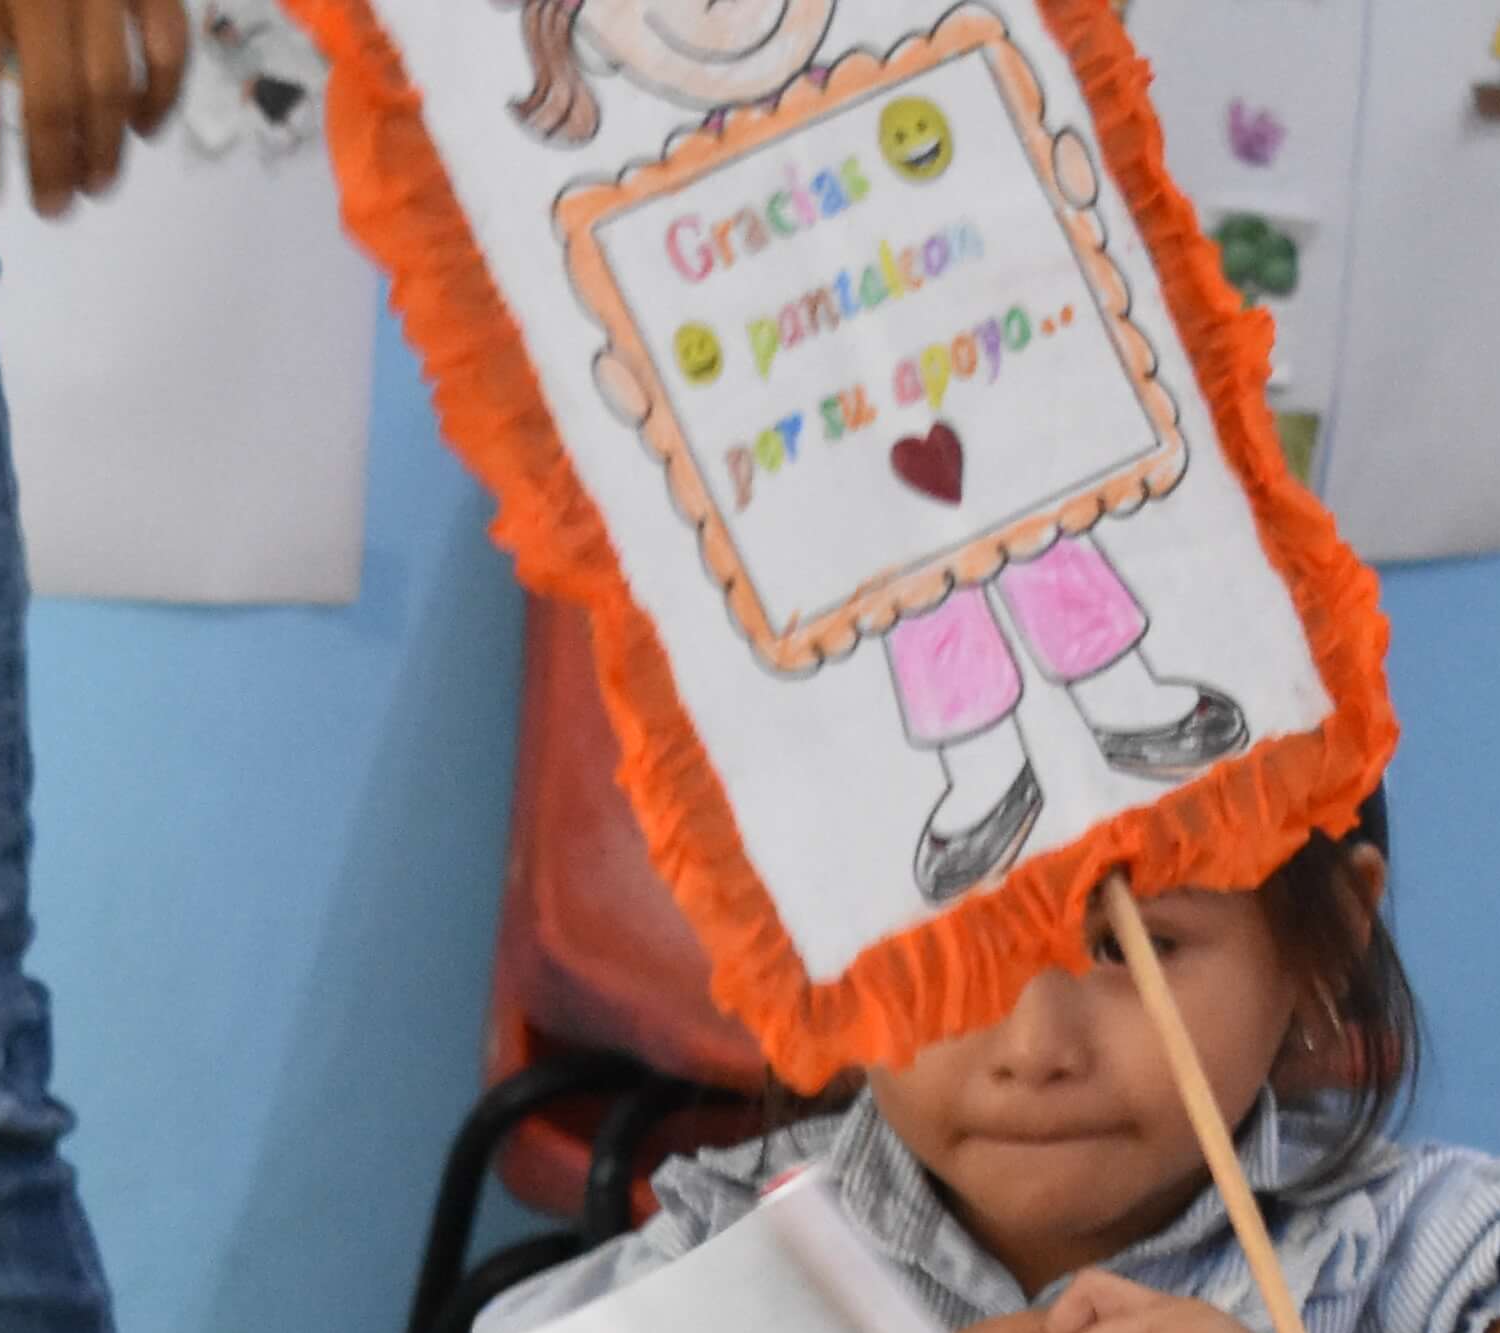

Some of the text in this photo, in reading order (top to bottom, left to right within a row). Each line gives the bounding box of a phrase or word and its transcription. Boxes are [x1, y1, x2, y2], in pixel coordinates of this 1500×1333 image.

[664, 154, 870, 283] Gracias
[746, 222, 985, 382] pantaleon
[726, 410, 804, 512] por
[819, 384, 877, 440] su
